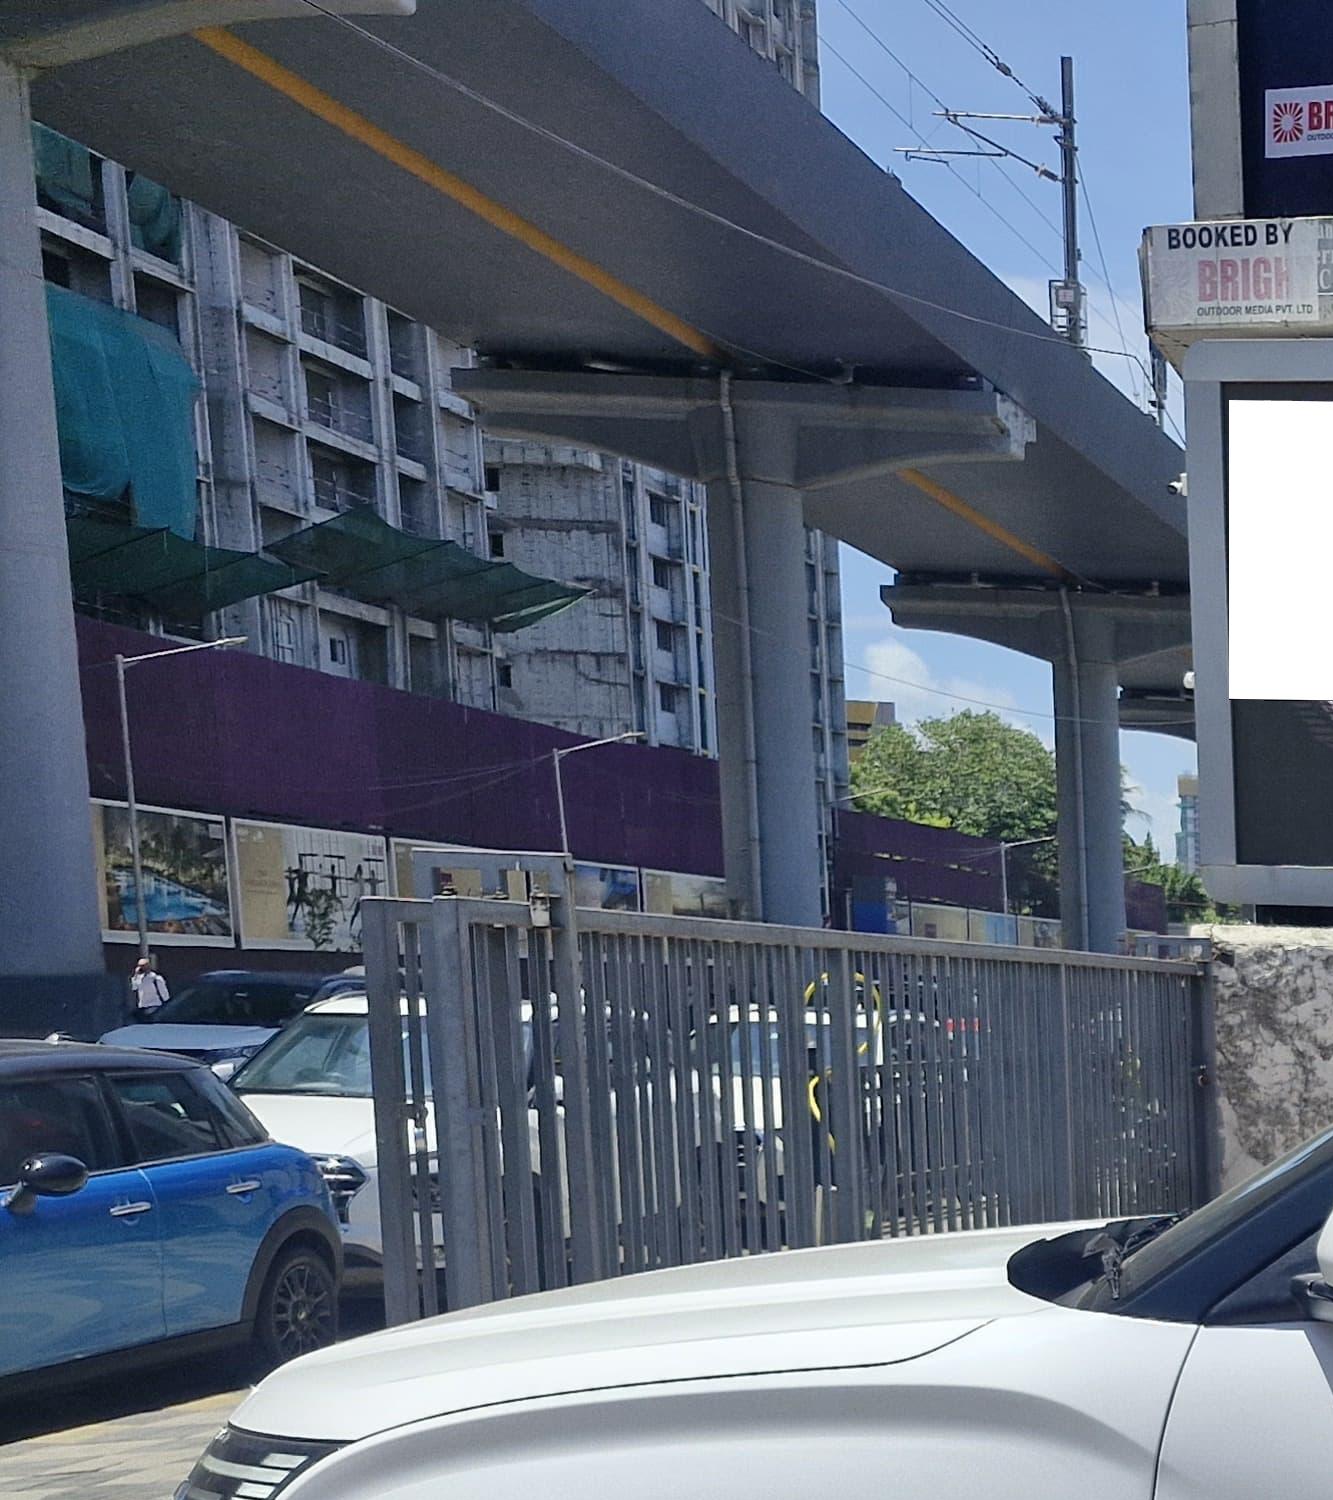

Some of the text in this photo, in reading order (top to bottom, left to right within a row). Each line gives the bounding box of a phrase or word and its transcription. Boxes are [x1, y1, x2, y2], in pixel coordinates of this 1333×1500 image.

[1168, 223, 1294, 250] BOOKED BY
[1197, 305, 1242, 317] OUTDOOR
[1245, 304, 1273, 315] MEDIA
